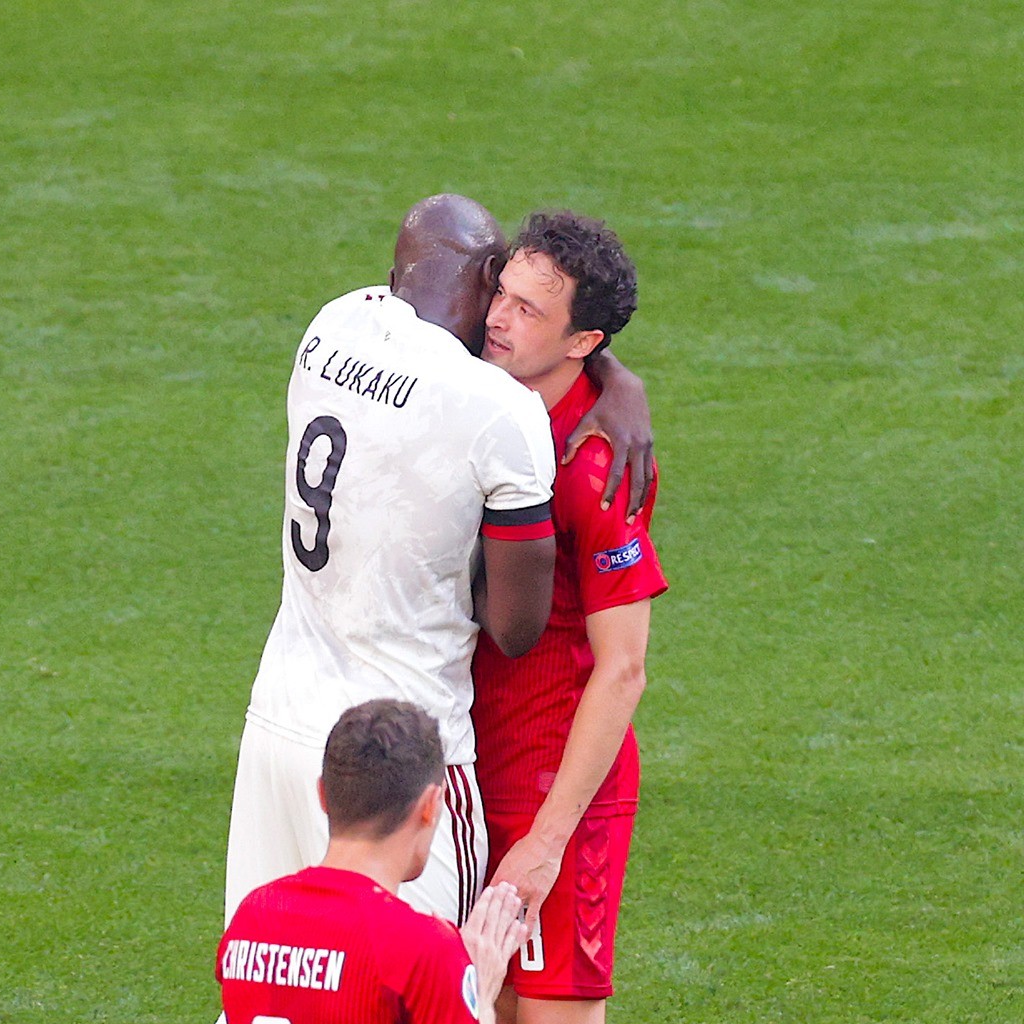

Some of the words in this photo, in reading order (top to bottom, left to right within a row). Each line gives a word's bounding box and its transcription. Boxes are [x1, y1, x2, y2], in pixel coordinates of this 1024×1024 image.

[299, 336, 321, 371] R.
[320, 350, 418, 408] LUKAKU
[291, 415, 347, 572] 9
[222, 939, 345, 992] CHRISTENSEN
